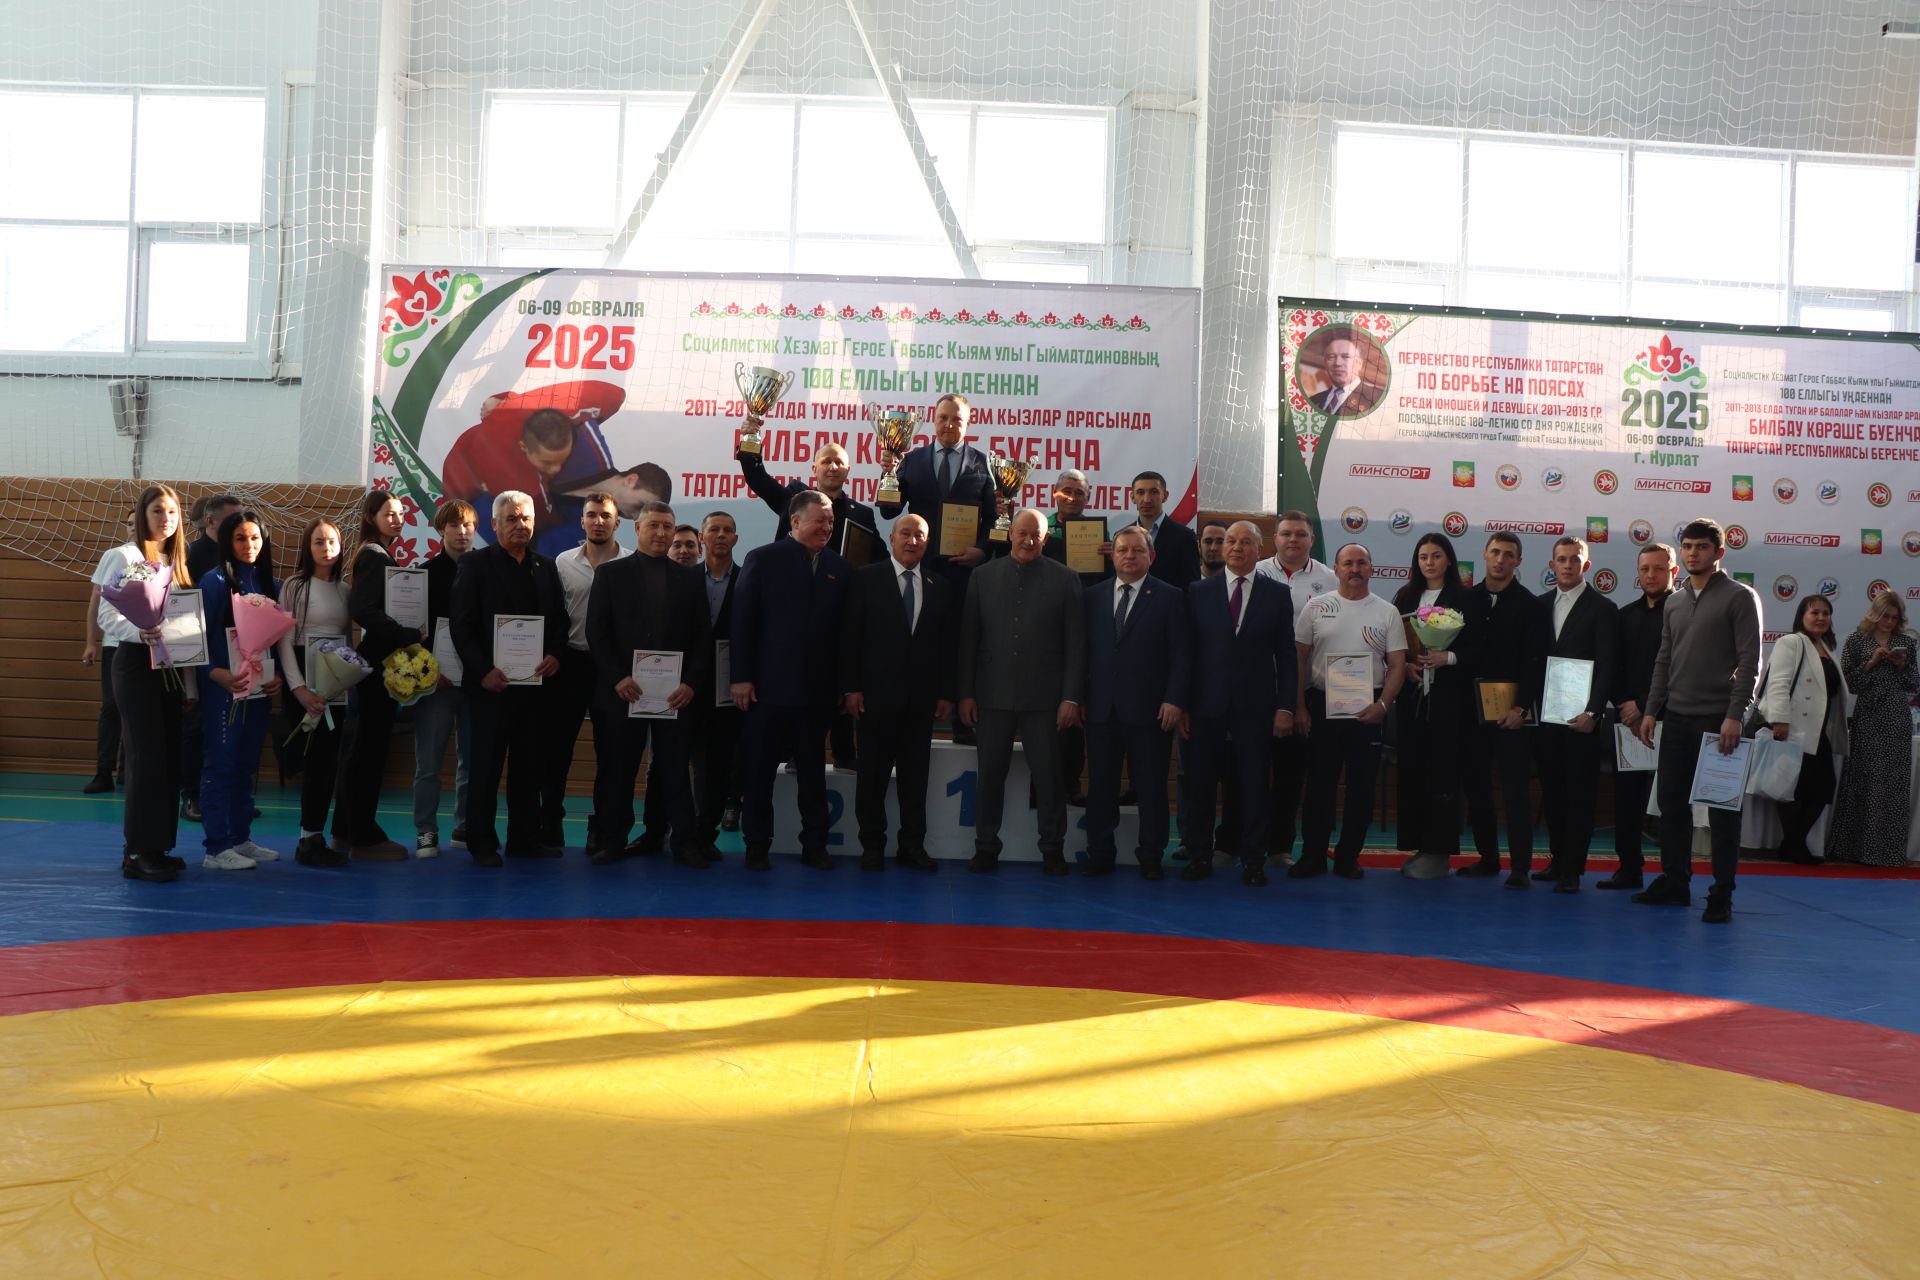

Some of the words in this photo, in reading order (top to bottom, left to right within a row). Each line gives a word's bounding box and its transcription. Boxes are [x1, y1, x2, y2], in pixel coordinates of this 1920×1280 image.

[518, 299, 562, 316] 06-09
[566, 300, 645, 318] ФЕВРАЛЯ
[525, 323, 636, 372] 2025
[1398, 351, 1469, 368] ПЕРВЕНСТВО
[1472, 355, 1542, 372] РЕСПУБЛИКИ
[1545, 359, 1604, 376] ТАТАРСТАН
[801, 367, 834, 389] 100
[840, 368, 928, 393] ЕЛЛЫГЫ
[1417, 372, 1437, 390] ПО
[1441, 373, 1500, 394] БОРЬБЕ
[1504, 376, 1524, 395] НА
[1528, 378, 1585, 398] ПОЯСАХ
[1779, 387, 1796, 400] 100
[1798, 388, 1840, 402] ЕЛЛЫГЫ
[1399, 396, 1432, 410] СРЕДИ
[1434, 398, 1480, 412] ЮНОШЕЙ
[1482, 400, 1489, 413] И
[1491, 401, 1539, 415] ДЕВУШЕК
[1620, 387, 1710, 431] 2025
[1763, 404, 1783, 415] ЕЛДА
[1785, 405, 1807, 416] ТУГАН
[1808, 407, 1819, 416] ИР
[1819, 407, 1854, 418] БАЛАЛАР
[1872, 410, 1903, 420] КЫЗЛАР
[811, 403, 857, 421] ТУГАН
[997, 408, 1062, 427] КЫЗЛАР
[1065, 410, 1152, 431] АРАСЫНДА
[1398, 412, 1467, 427] ПОСВЯЩЕННОЕ
[1469, 416, 1519, 430] 100-ЛЕТИЮ
[1521, 419, 1533, 430] СО
[1535, 420, 1553, 431] ДНЯ
[1554, 421, 1603, 434] РОЖДЕНИЯ
[1626, 433, 1654, 445] 06-09
[1656, 435, 1704, 447] ФЕВРАЛЯ
[1749, 418, 1804, 437] БИЛБАУ
[1806, 421, 1865, 440] КӨРӘШЕ
[1869, 424, 1920, 443] БУЕНЧА
[990, 436, 1100, 471] БУЕНЧА
[1649, 449, 1699, 467] Нурлат
[1726, 440, 1783, 456] ТАТАРСТАН
[1785, 443, 1869, 460] РЕСПУБЛИКАСЫ
[1351, 465, 1430, 479] МИНСПОРТ
[1636, 480, 1711, 492] МИНСПОРТ
[1487, 522, 1565, 535] МИНСПОРТ
[1766, 534, 1840, 547] МИНСПОРТ
[946, 770, 977, 827] 1
